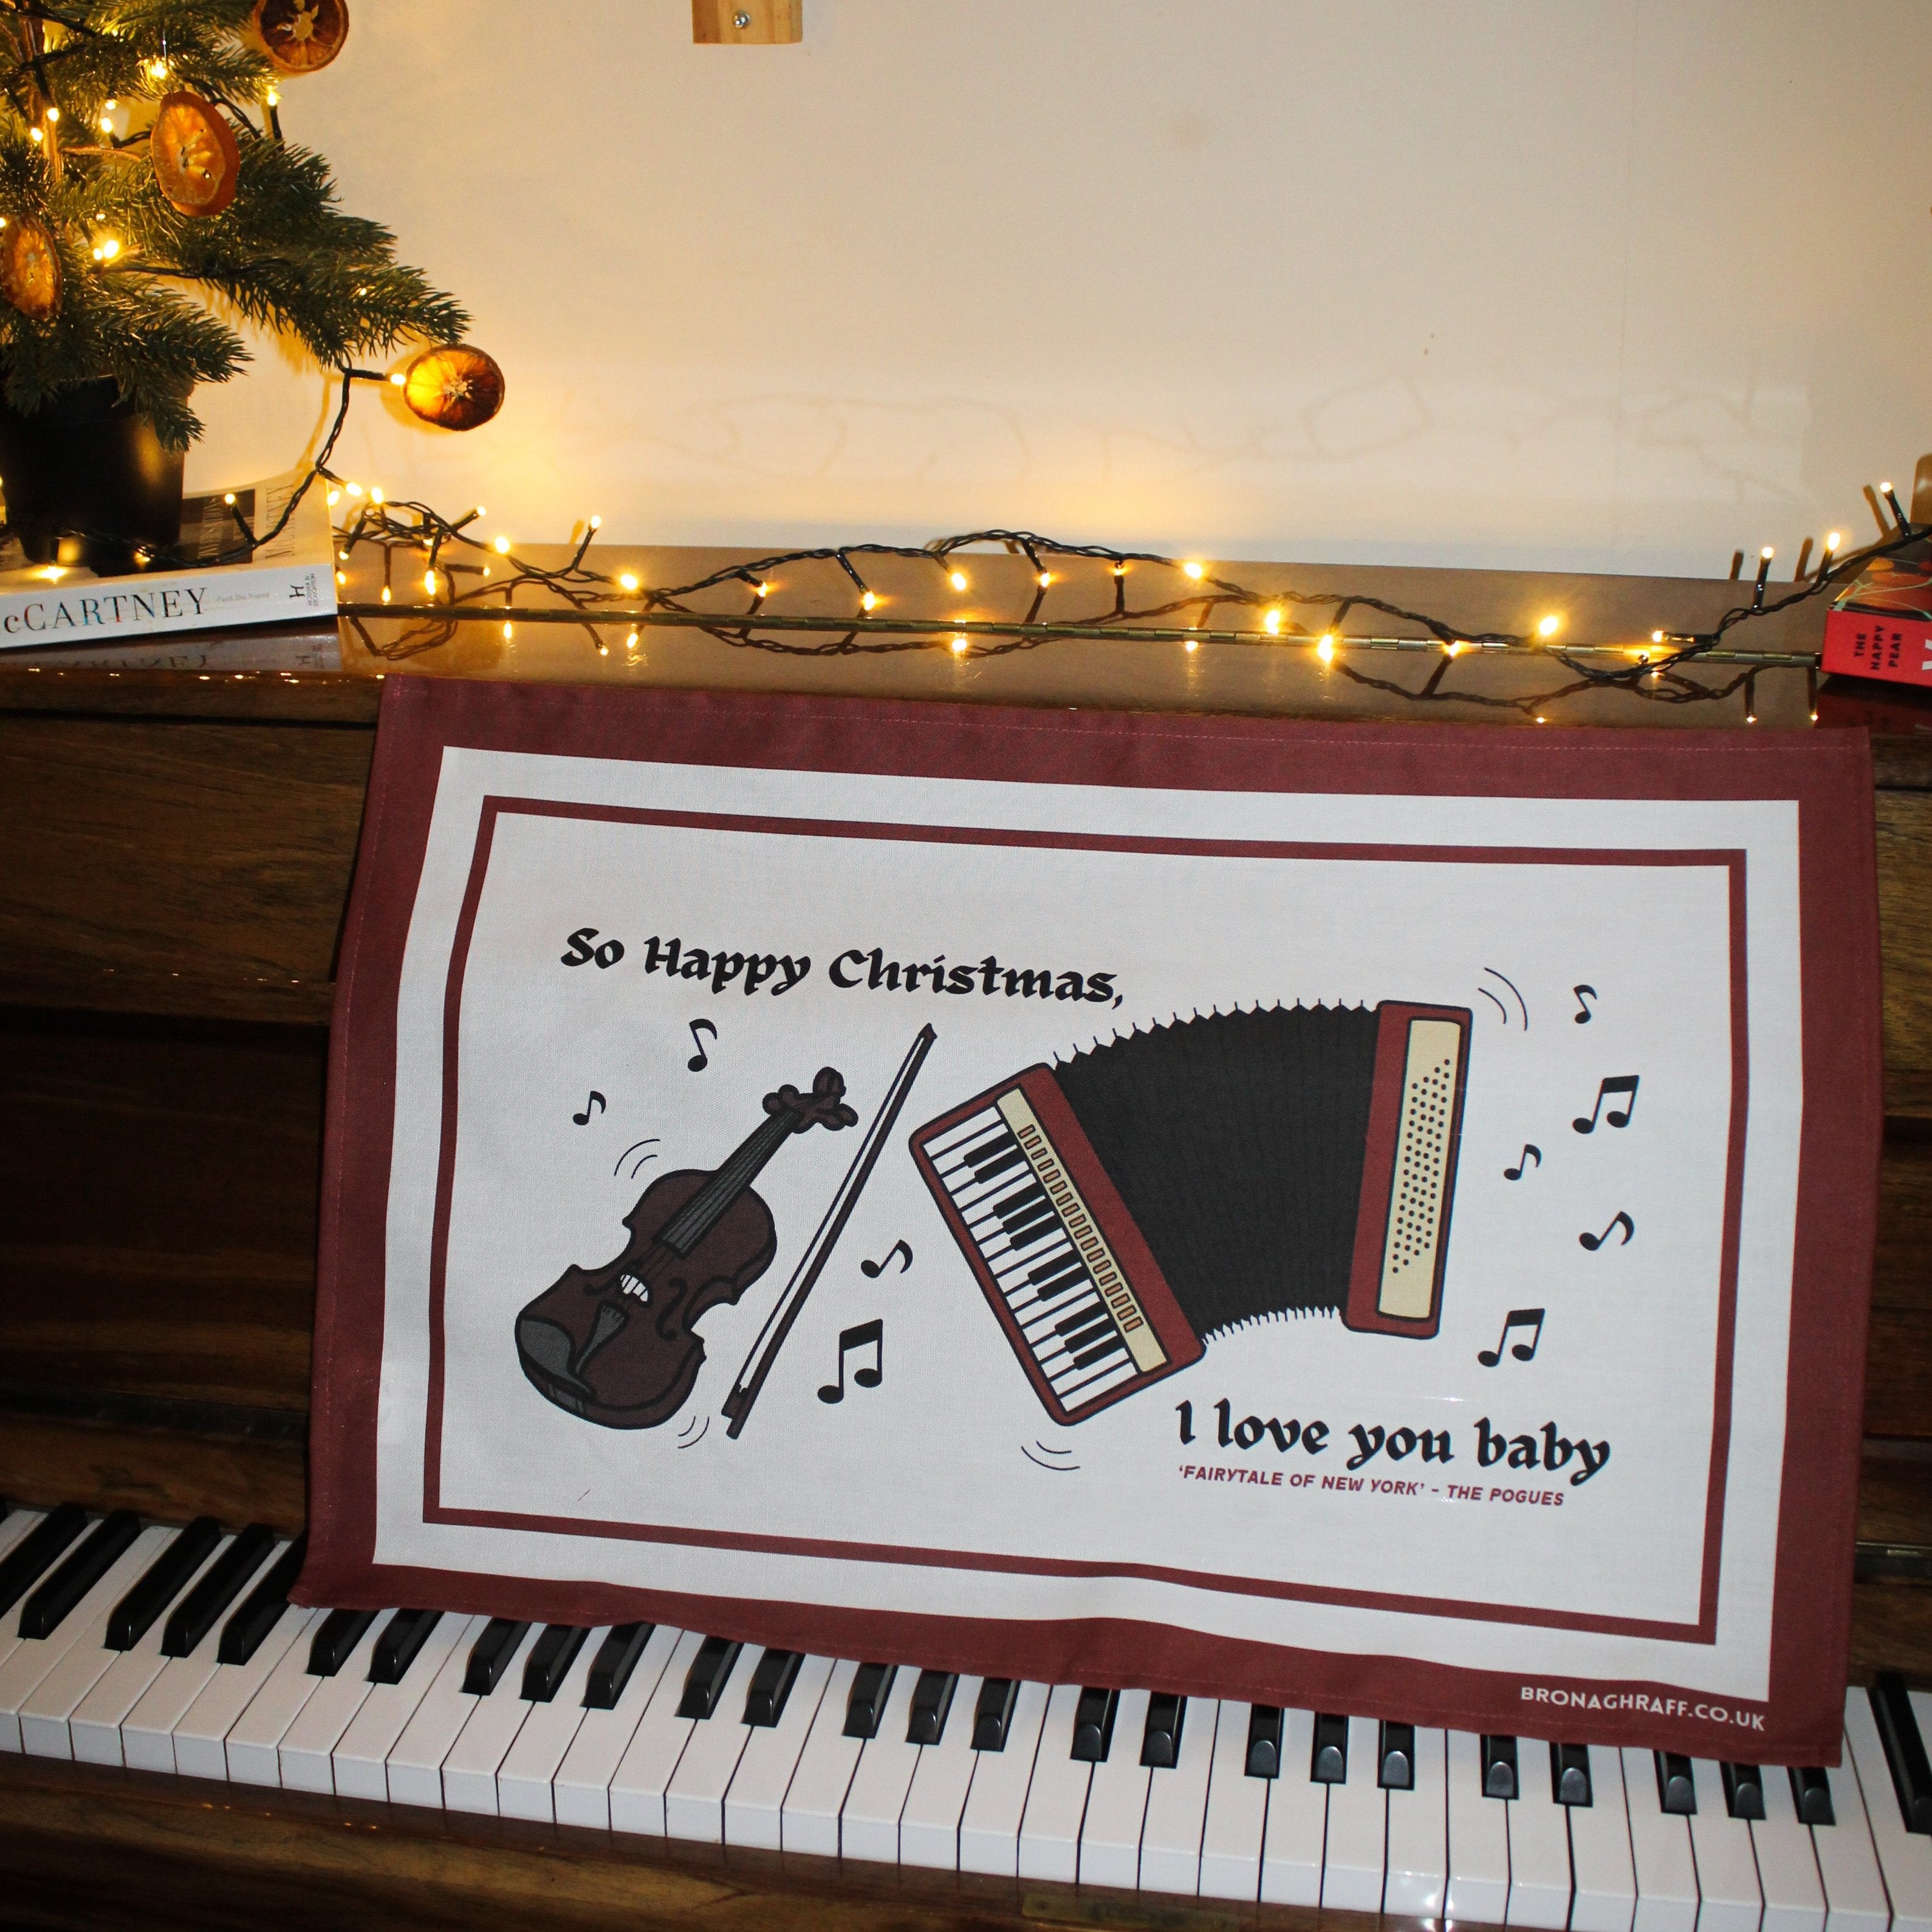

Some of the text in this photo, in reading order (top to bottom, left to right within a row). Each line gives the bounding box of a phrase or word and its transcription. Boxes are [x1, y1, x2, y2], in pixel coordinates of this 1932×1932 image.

[0, 587, 207, 634] cCARTNEY
[1854, 633, 1867, 657] THE
[1870, 625, 1885, 671] HAPPY
[1888, 633, 1902, 668] PEAR
[560, 927, 1123, 1010] So Happy Christmas,
[1213, 1398, 1330, 1455] love
[1346, 1424, 1454, 1471] you
[1473, 1417, 1611, 1487] baby
[1290, 1474, 1315, 1487] OF
[1321, 1476, 1364, 1491] NEW
[1448, 1484, 1483, 1500] THE
[1489, 1488, 1564, 1506] POGUES
[1521, 1687, 1765, 1732] BRONAGHRAFF.CO.UK
